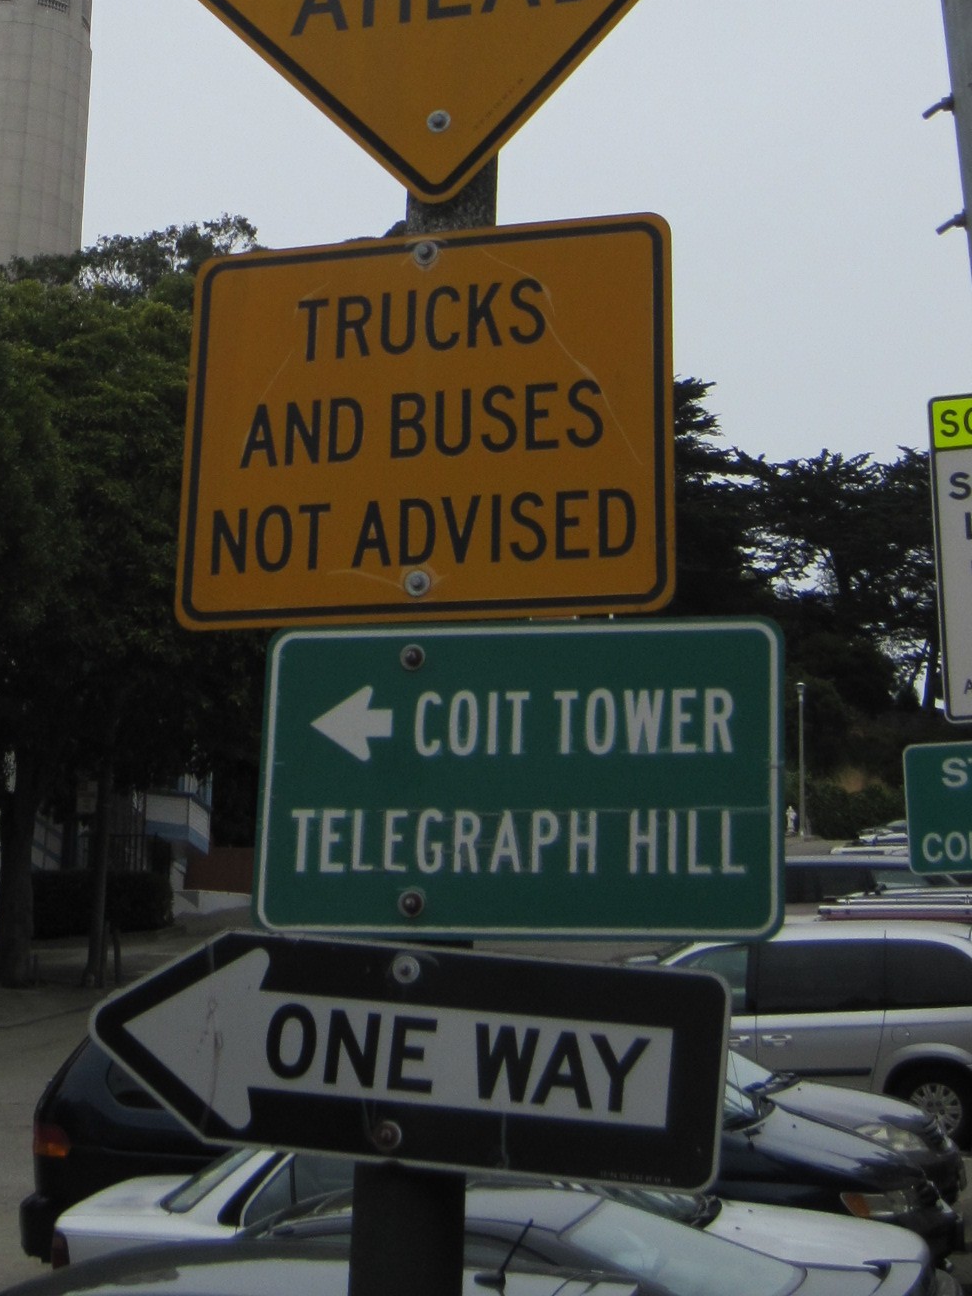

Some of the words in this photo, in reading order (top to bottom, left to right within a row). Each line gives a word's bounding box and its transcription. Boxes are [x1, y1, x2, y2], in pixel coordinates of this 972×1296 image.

[298, 278, 546, 362] TRUCKS
[239, 397, 364, 469] AND
[390, 379, 604, 459] BUSES
[210, 504, 331, 576] NOT
[352, 488, 637, 568] ADVISED
[413, 691, 530, 756] COIT
[553, 688, 735, 756] TOWER
[292, 808, 598, 873] TELEGRAPH
[630, 809, 746, 874] HILL
[922, 831, 972, 863] CO
[265, 1004, 438, 1096] ONE
[475, 1022, 651, 1113] WAY
